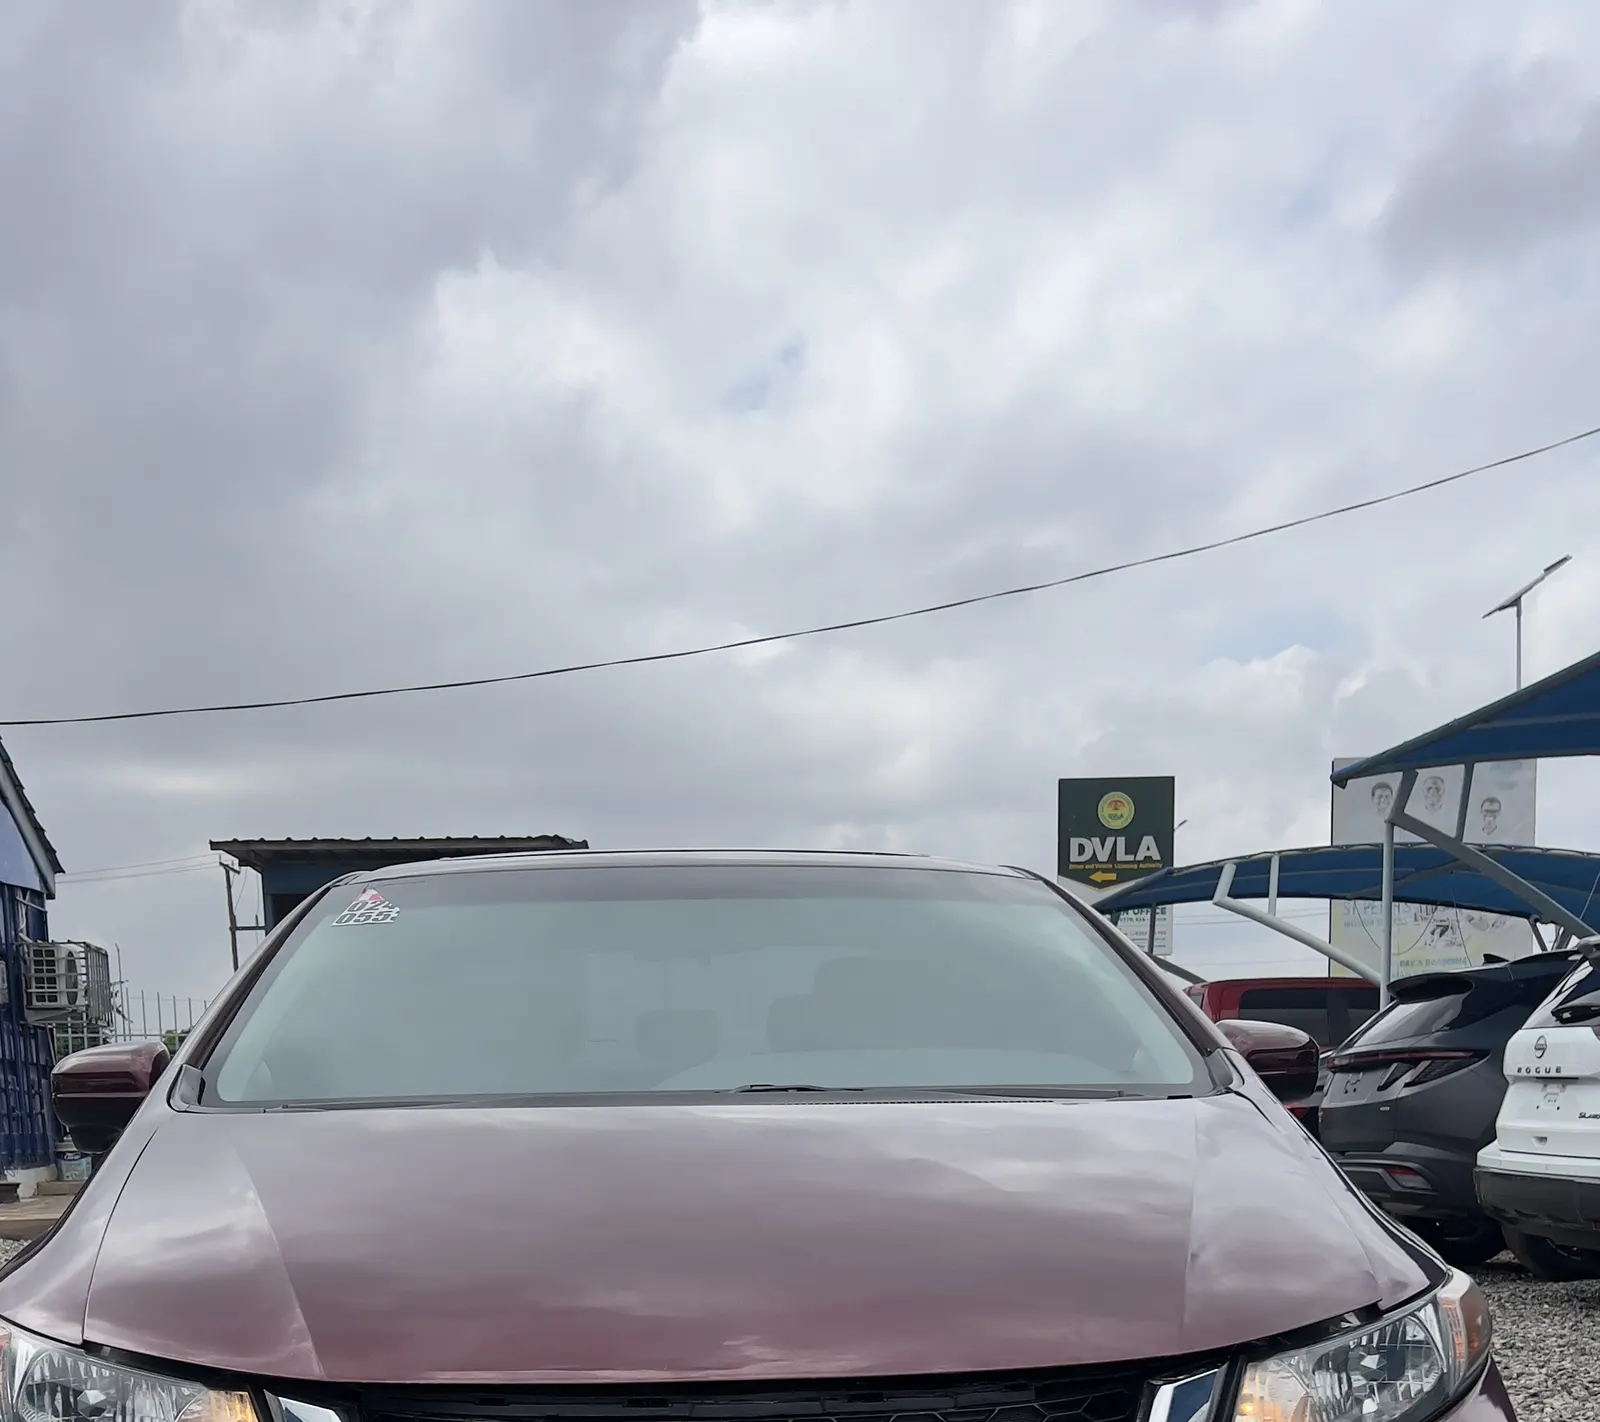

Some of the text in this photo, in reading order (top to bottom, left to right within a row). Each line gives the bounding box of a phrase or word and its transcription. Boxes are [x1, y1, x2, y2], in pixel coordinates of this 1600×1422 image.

[1069, 835, 1162, 862] DVLA
[1133, 907, 1167, 915] OFFCE
[1517, 1066, 1562, 1074] ROGUE
